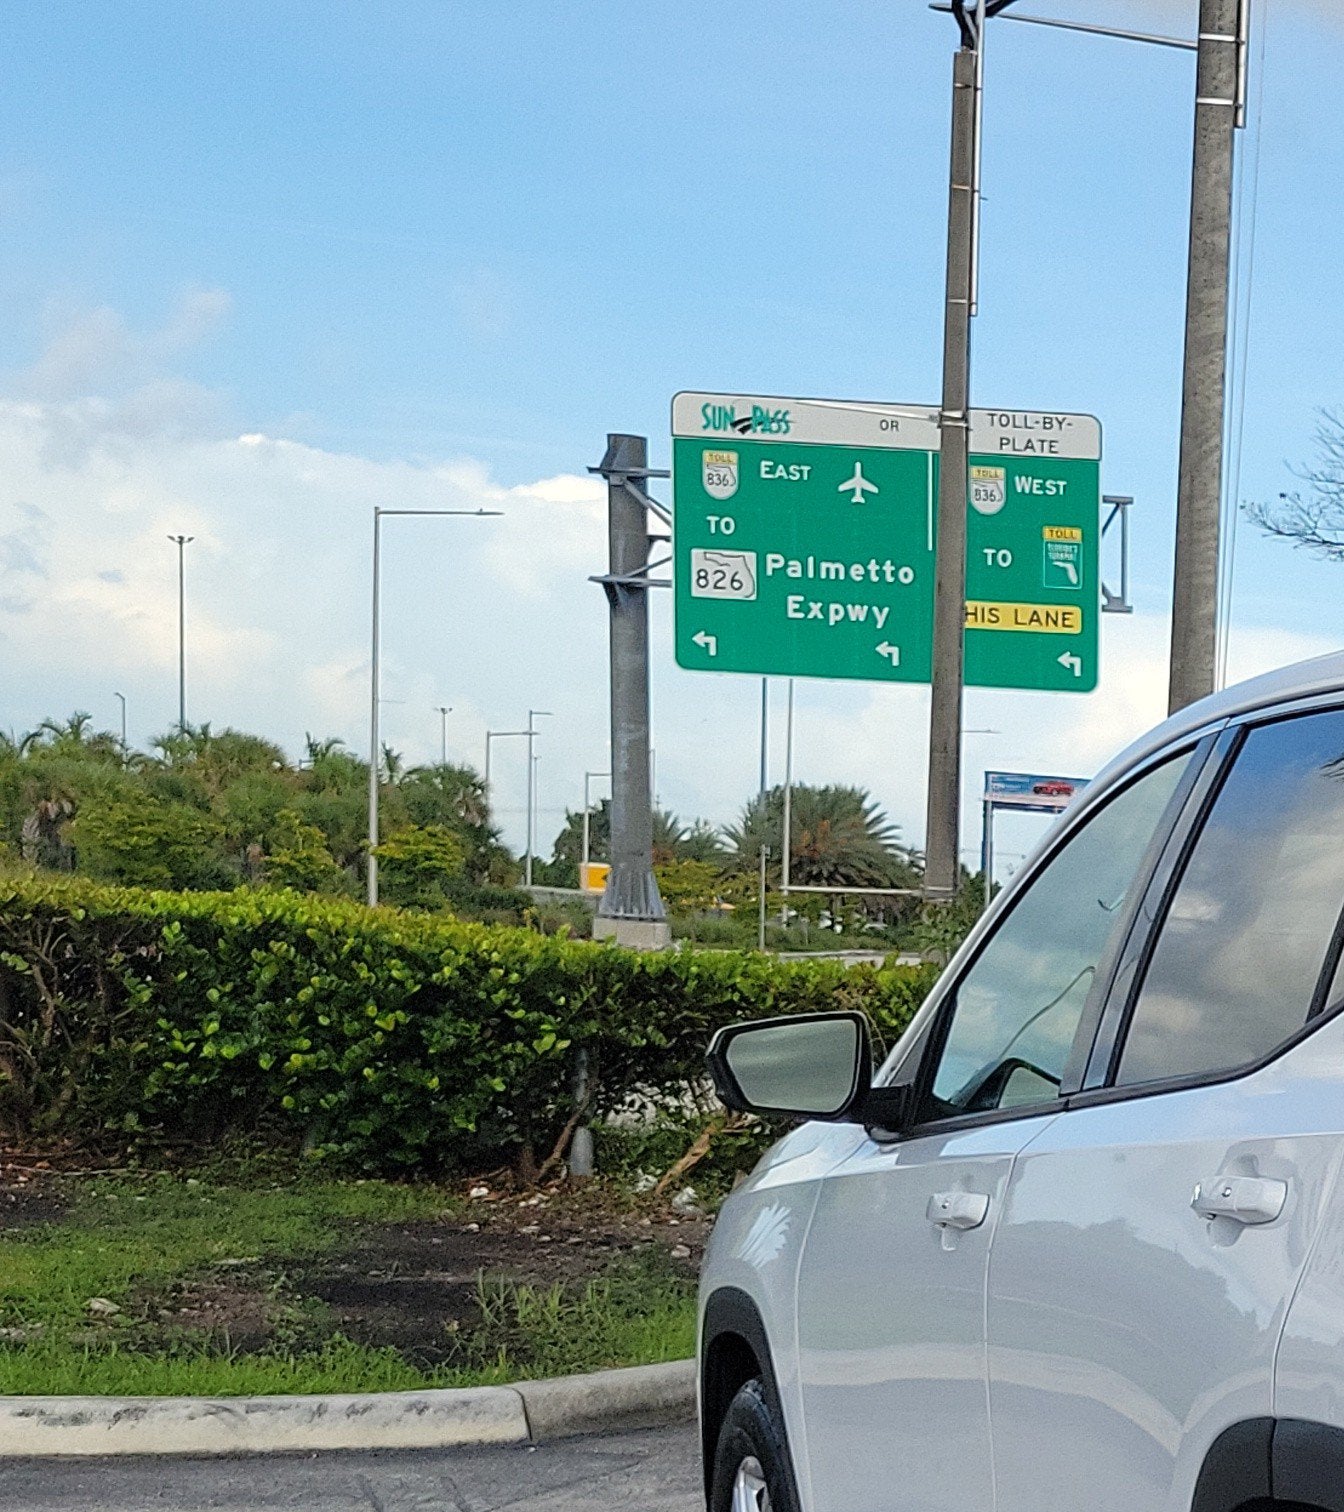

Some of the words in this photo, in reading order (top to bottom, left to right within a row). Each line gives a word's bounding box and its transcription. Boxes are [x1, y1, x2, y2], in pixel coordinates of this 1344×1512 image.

[879, 419, 900, 432] OR
[987, 412, 1074, 431] TOLL-BY-
[999, 437, 1059, 454] PLATE
[708, 453, 733, 463] TOLL
[707, 472, 730, 487] 836
[760, 460, 812, 481] EAST
[976, 469, 1000, 479] TOLL
[974, 488, 997, 502] 836
[1014, 475, 1068, 496] WEST
[706, 515, 736, 536] TO
[1049, 529, 1078, 540] TOLL
[982, 548, 1013, 568] TO
[765, 553, 915, 584] Palmetto
[696, 568, 744, 591] 826
[786, 594, 890, 629] Expwy
[964, 605, 1001, 624] HIS
[1014, 608, 1075, 629] LANE
